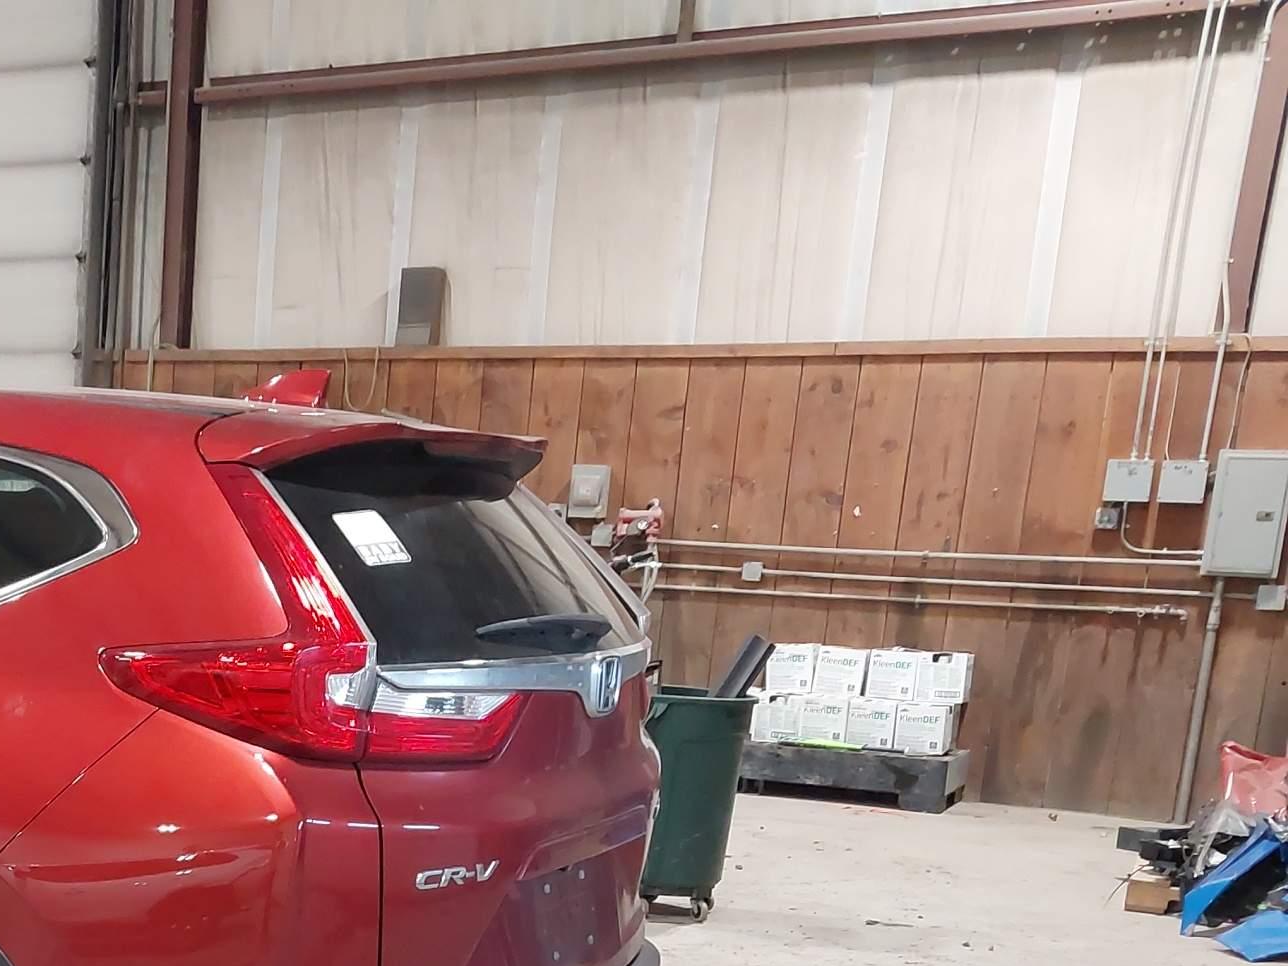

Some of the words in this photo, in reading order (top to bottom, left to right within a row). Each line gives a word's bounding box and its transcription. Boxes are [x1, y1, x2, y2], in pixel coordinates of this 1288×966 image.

[821, 656, 859, 668] KleenDEF
[872, 659, 912, 669] KleenDEF
[899, 714, 940, 724] KleenDEF
[416, 860, 499, 889] CR-V
